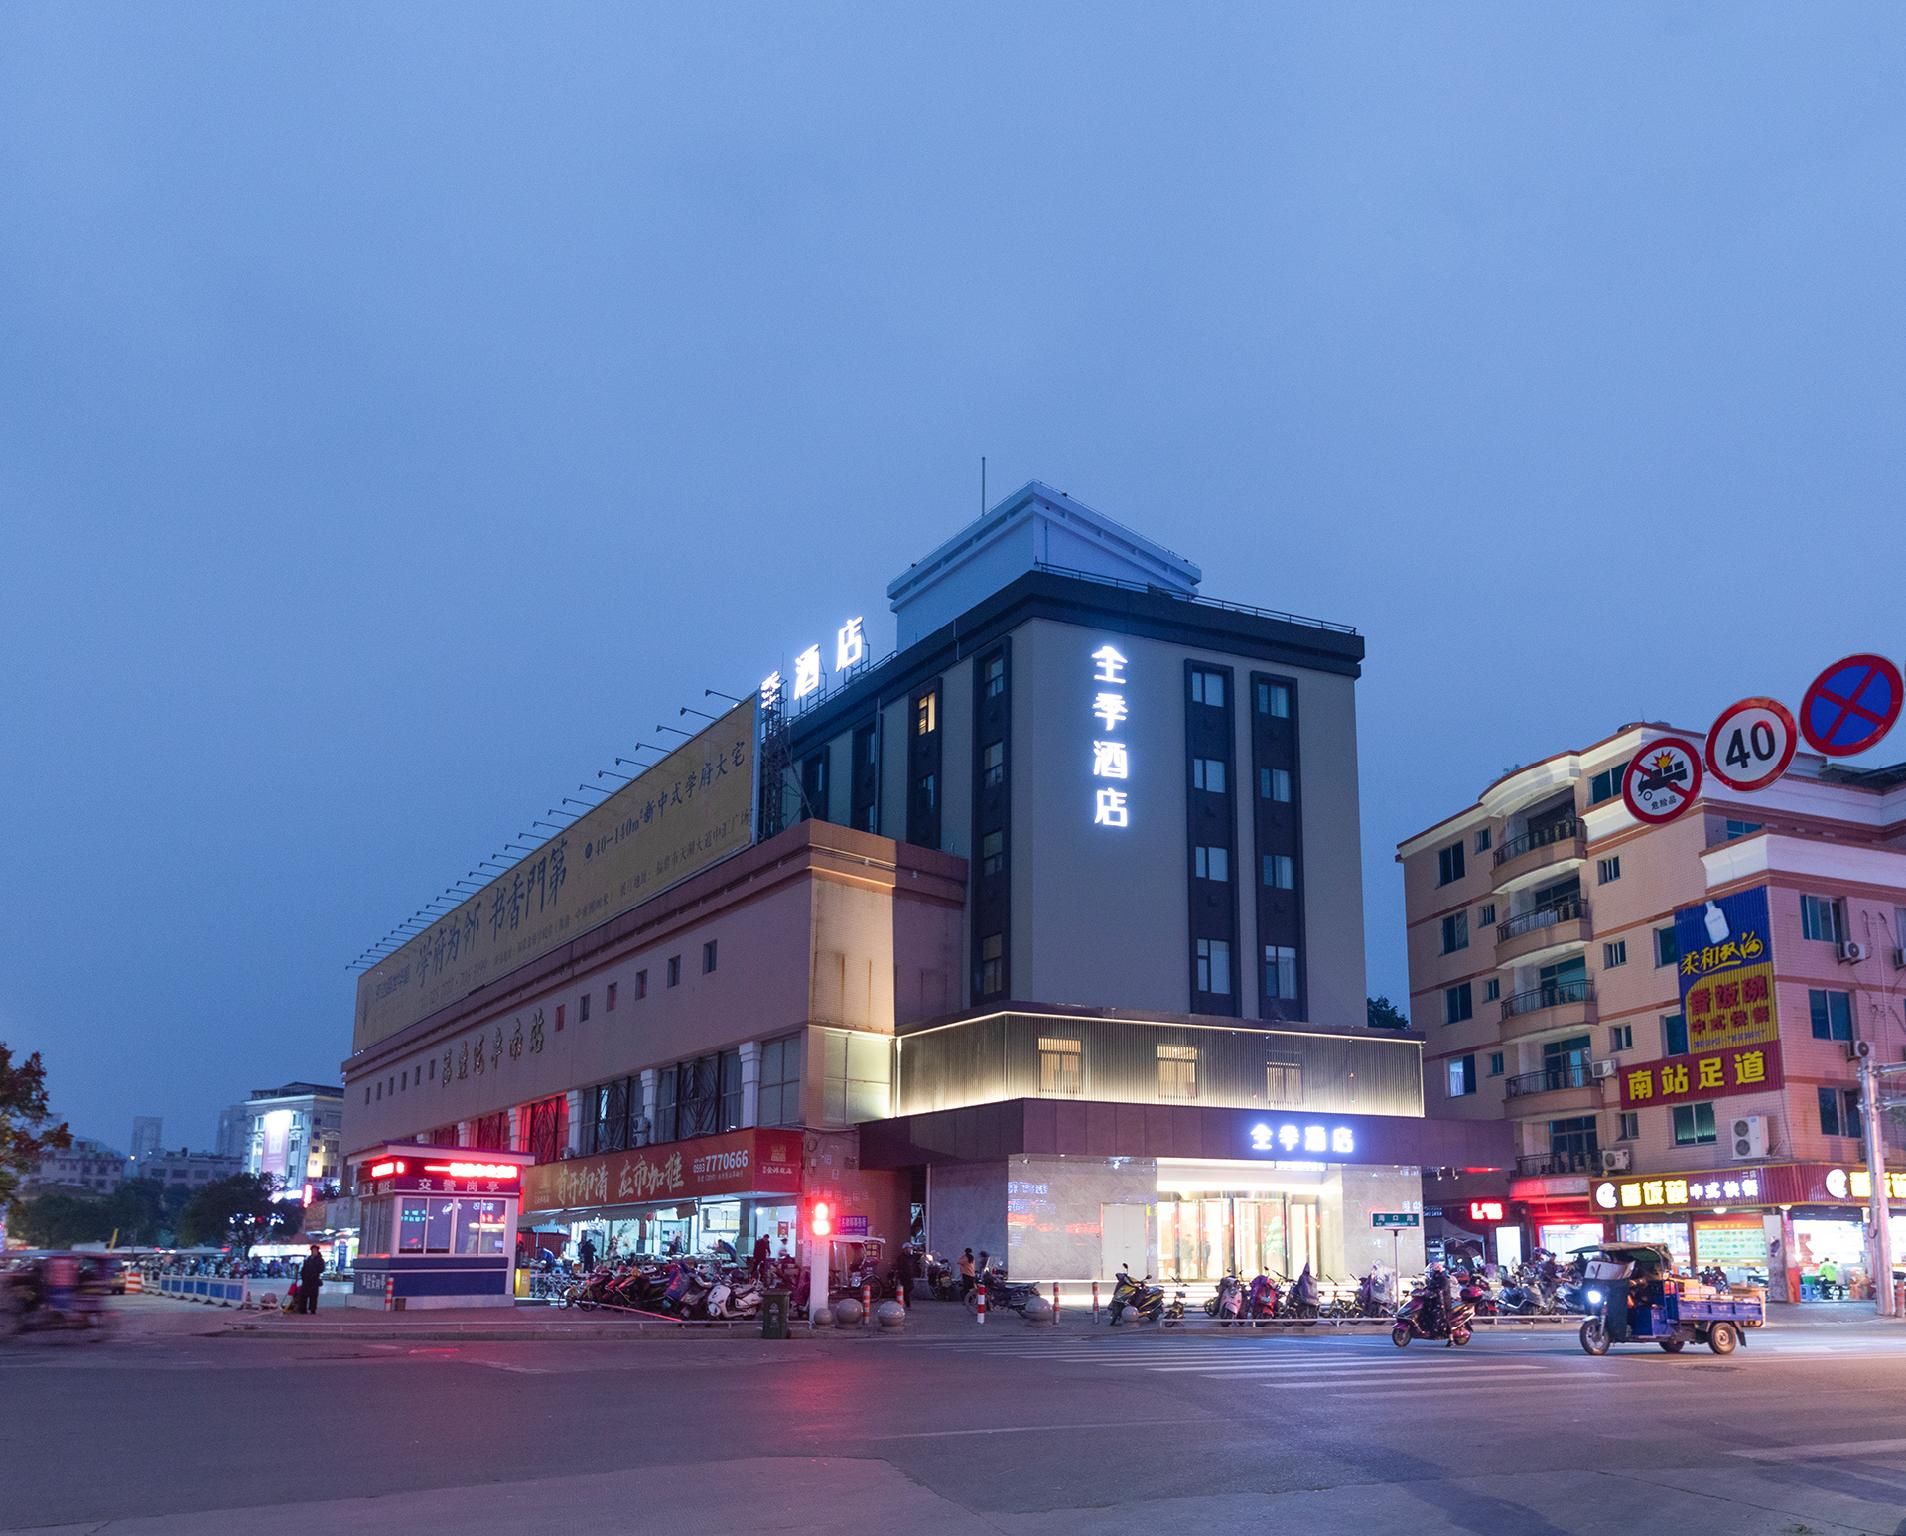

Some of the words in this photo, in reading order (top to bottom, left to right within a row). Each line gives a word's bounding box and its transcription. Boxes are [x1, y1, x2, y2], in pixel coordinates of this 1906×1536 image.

[1091, 645, 1129, 828] 全季酒店
[1725, 719, 1776, 769] 40
[1627, 1050, 1767, 1100] 南站足道
[1250, 1123, 1355, 1153] 全季酒店
[705, 1149, 749, 1173] 7770666
[418, 1178, 499, 1193] 交警岗亭
